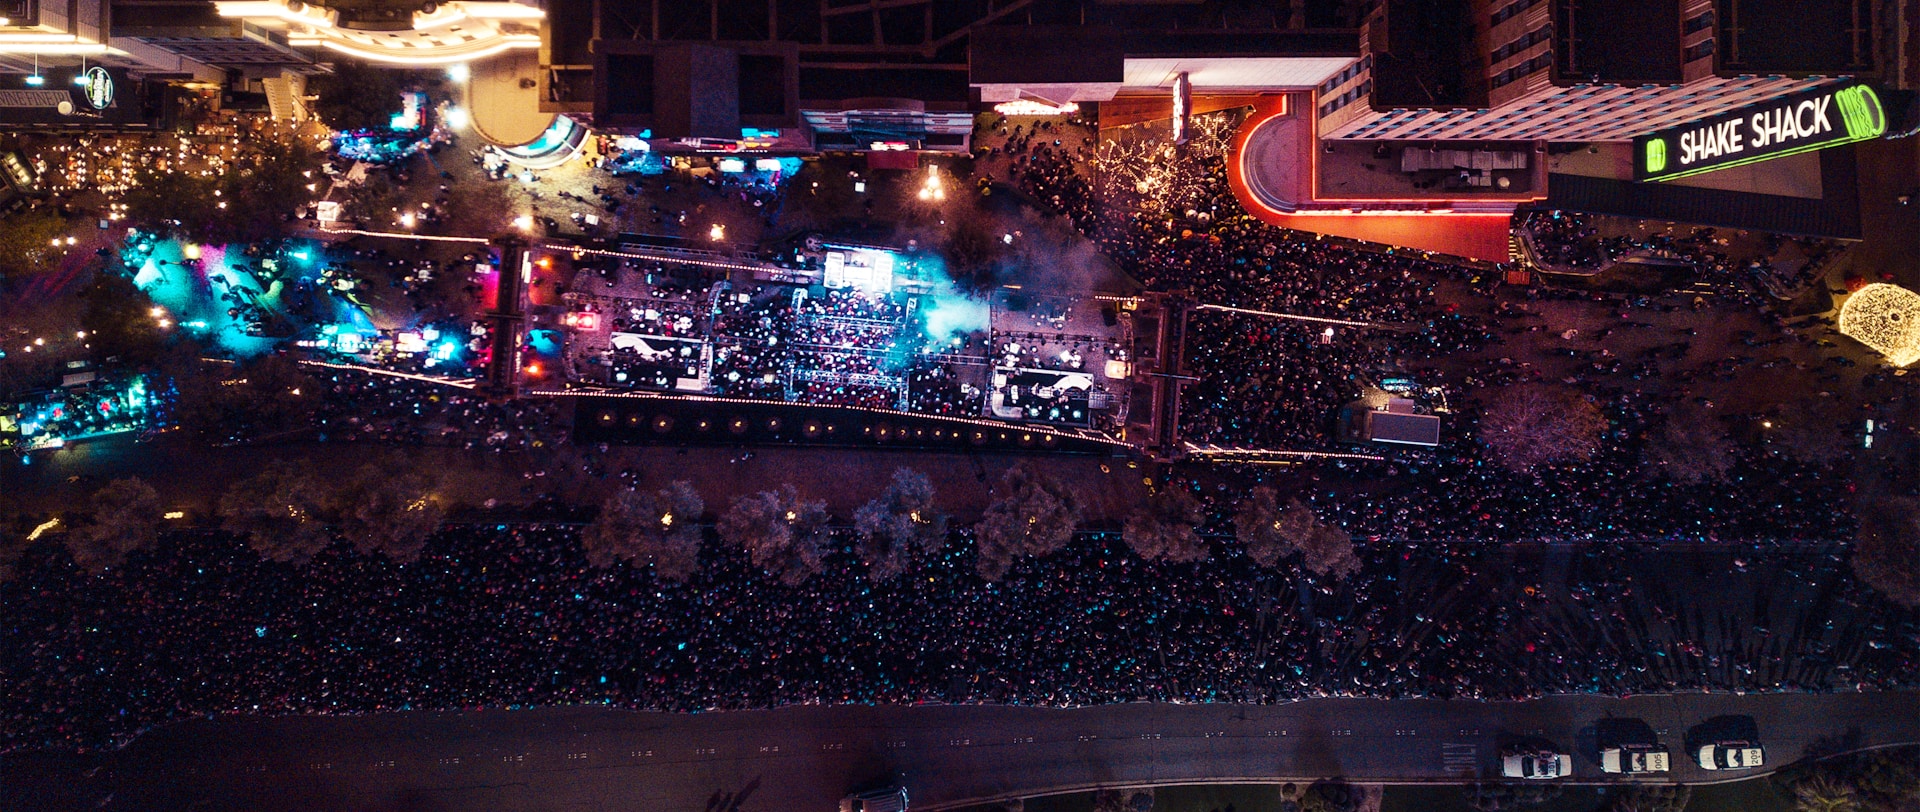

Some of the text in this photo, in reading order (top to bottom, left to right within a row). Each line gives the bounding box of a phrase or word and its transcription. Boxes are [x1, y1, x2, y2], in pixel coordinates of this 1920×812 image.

[25, 91, 55, 106] FINE
[1680, 94, 1832, 165] SHAKE SHACK
[1751, 749, 1759, 765] 209
